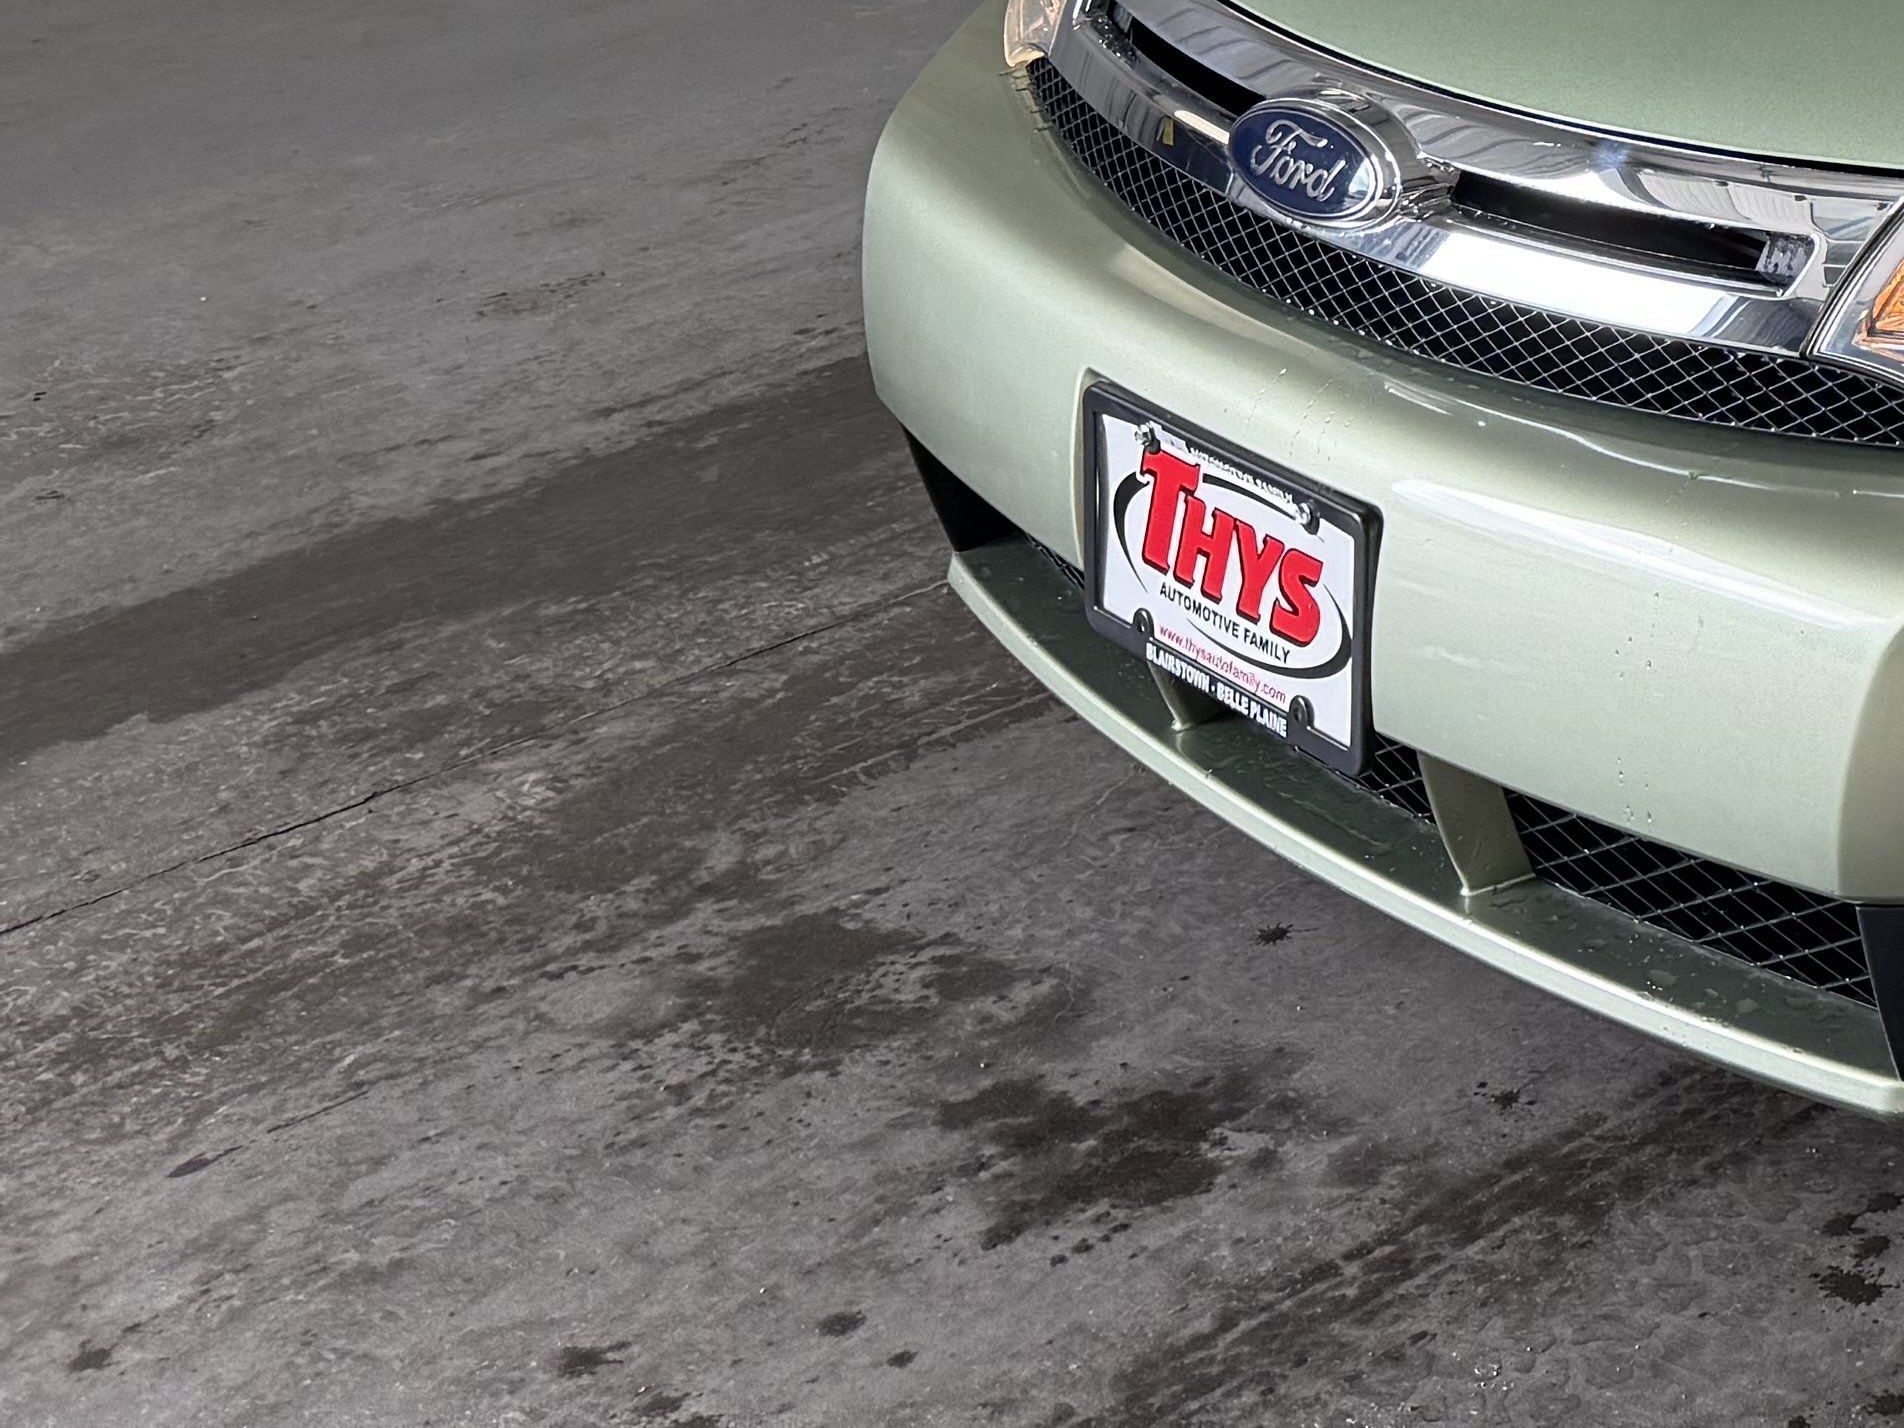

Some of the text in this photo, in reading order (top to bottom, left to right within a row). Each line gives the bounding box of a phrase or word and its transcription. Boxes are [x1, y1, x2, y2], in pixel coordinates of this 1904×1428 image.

[1251, 118, 1346, 202] Ford
[1140, 447, 1324, 647] THYS
[1160, 581, 1290, 664] AUTOMOTIVE FAMILY
[1146, 644, 1288, 739] BLAIRSTOWN BELLE PLAINE
